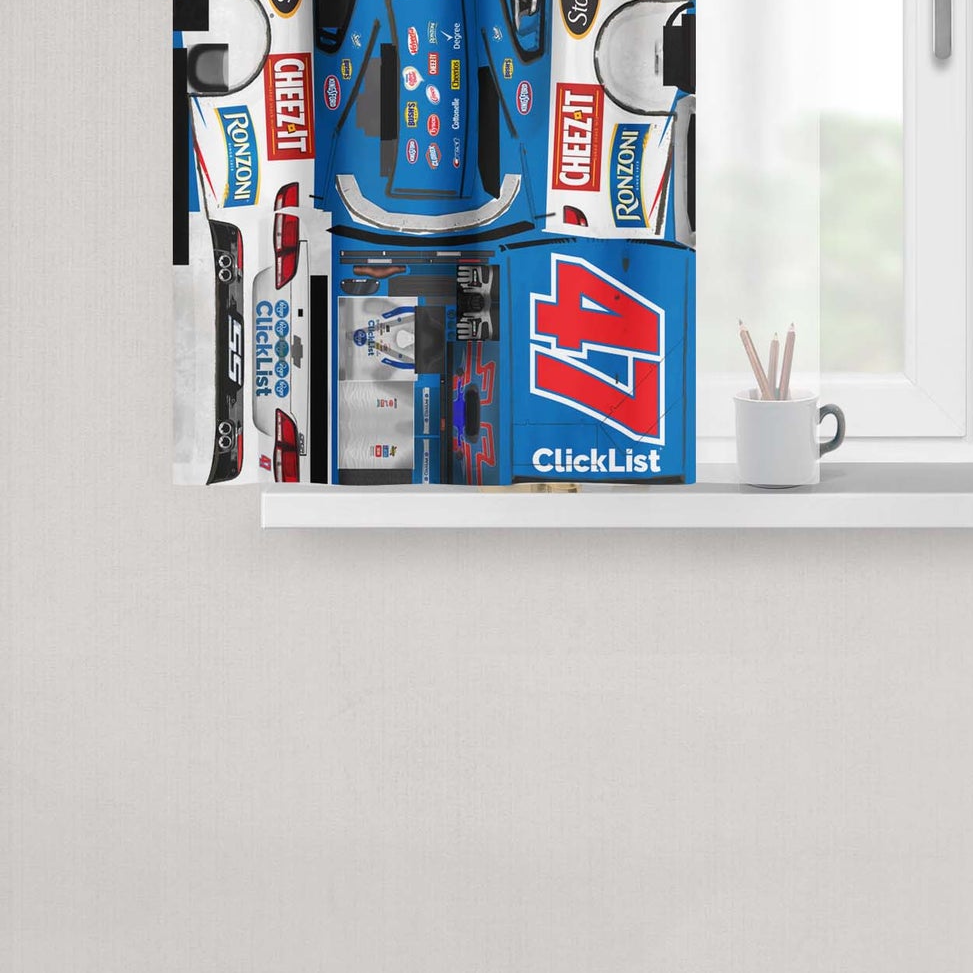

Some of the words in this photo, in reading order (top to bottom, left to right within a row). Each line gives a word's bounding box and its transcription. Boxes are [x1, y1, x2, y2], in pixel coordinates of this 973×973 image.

[453, 23, 462, 49] Degree
[452, 61, 460, 88] Cheerios
[451, 98, 460, 129] Cottonelle
[224, 113, 252, 201] RONZONI
[616, 130, 639, 221] RONZONI
[228, 315, 242, 386] SS
[256, 300, 273, 397] ClickList
[530, 253, 665, 445] 47
[532, 447, 662, 473] ClickList
